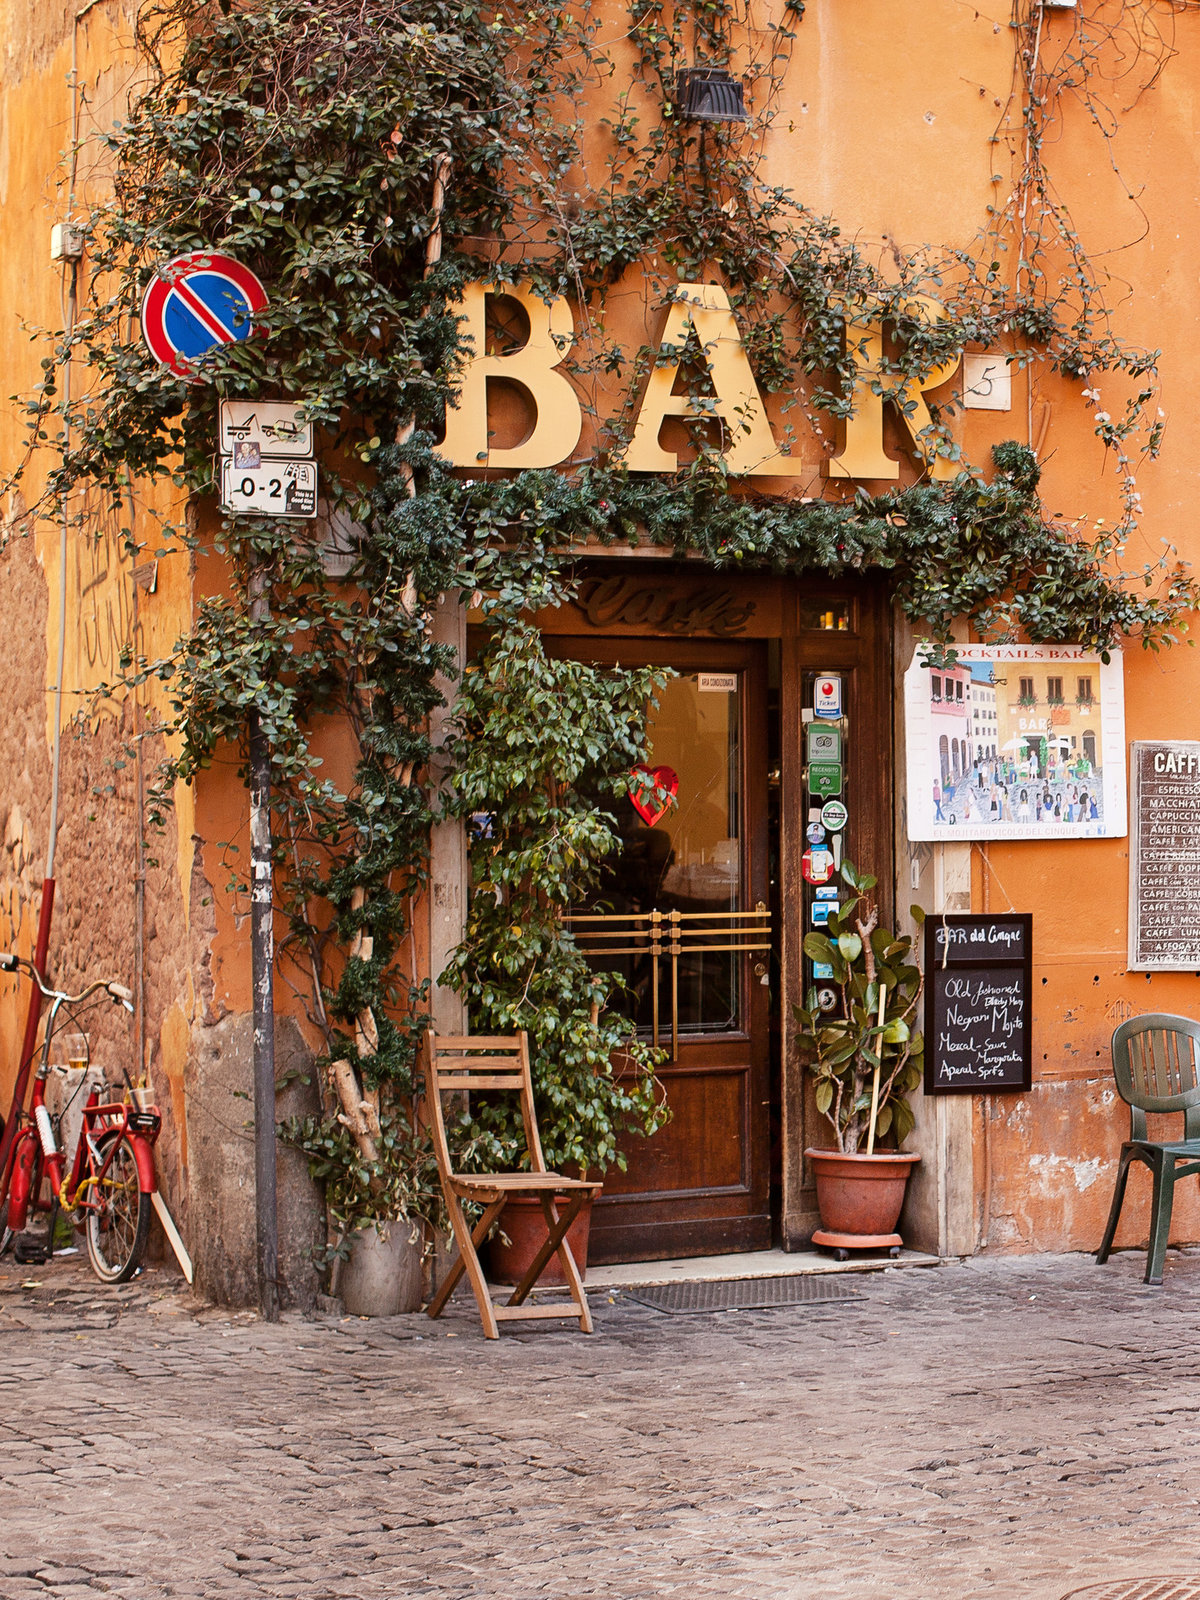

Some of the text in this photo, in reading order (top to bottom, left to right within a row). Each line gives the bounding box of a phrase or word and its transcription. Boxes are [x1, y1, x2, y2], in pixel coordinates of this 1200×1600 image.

[430, 282, 966, 481] BAR
[967, 366, 993, 396] 5
[1050, 649, 1084, 659] BAR
[1019, 717, 1048, 731] BAR
[1158, 786, 1200, 795] ESPRESSO
[1045, 826, 1078, 837] CINQUE
[970, 928, 986, 943] del
[944, 978, 1021, 1007] Old fashioned
[991, 1006, 1024, 1038] Mojito
